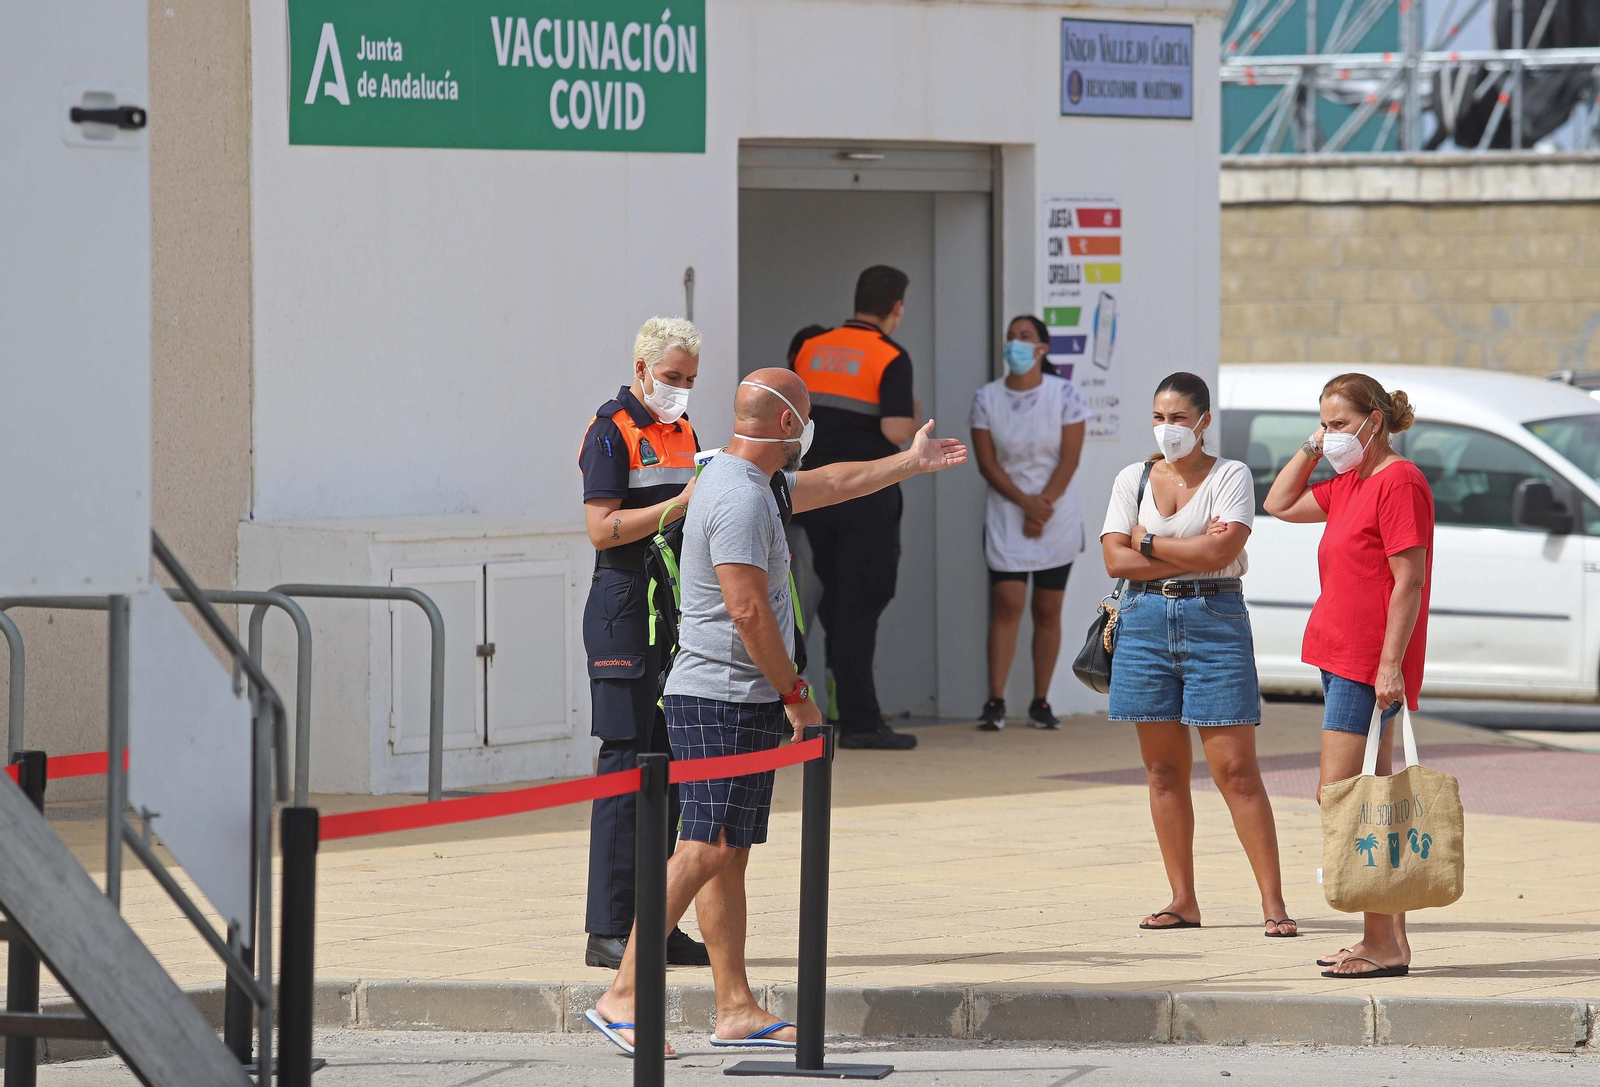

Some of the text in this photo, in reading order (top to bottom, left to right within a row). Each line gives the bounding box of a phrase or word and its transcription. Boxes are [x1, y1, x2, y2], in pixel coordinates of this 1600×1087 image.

[356, 35, 403, 62] Junta
[490, 7, 698, 74] VACUNACIÓN
[357, 70, 459, 101] de Andalucía
[549, 79, 646, 131] COVID
[1360, 801, 1373, 825] ALL
[1413, 793, 1424, 818] IS
